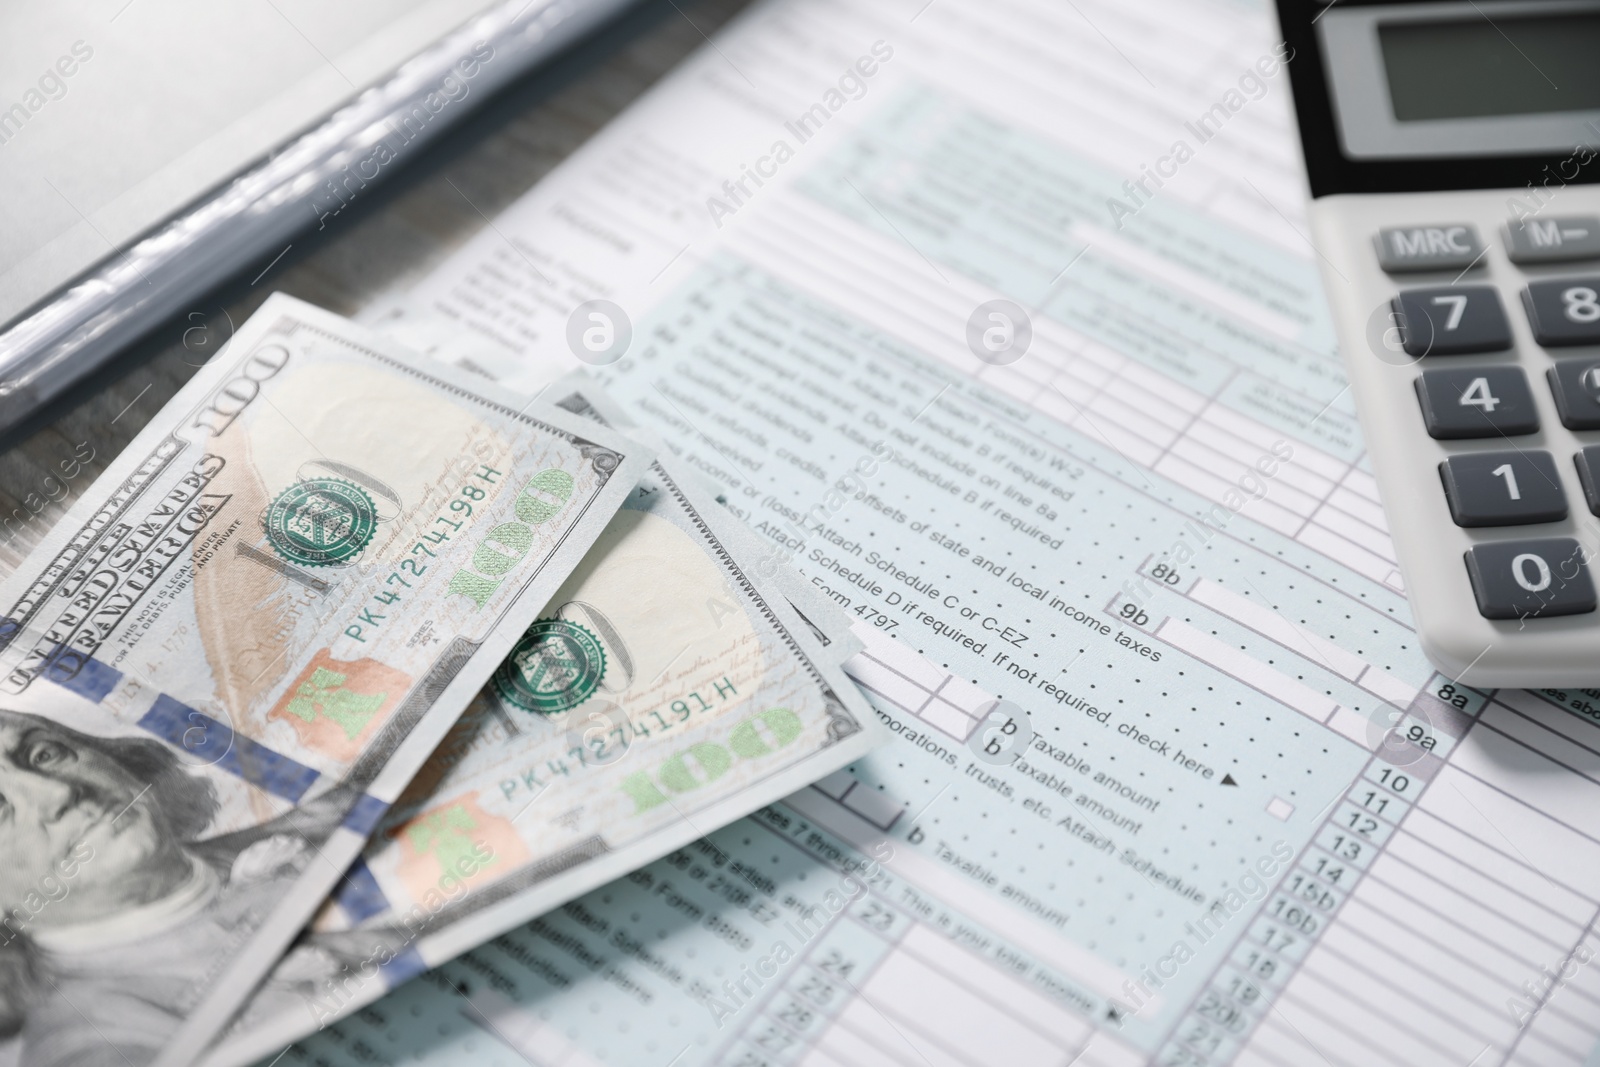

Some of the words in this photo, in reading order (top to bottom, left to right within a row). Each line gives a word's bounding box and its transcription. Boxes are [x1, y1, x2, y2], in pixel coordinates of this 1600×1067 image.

[1392, 226, 1471, 257] MRC
[1432, 295, 1467, 331] 7
[1561, 286, 1600, 322] 8
[193, 343, 290, 438] 100
[1458, 377, 1500, 412] 4
[80, 437, 181, 542] DOLLARS
[919, 442, 977, 477] include
[979, 475, 1001, 490] on
[1003, 485, 1033, 507] line
[1005, 461, 1076, 502] required
[1491, 463, 1521, 500] 1
[963, 491, 979, 504] B
[993, 506, 1065, 552] required
[57, 522, 133, 598] THE
[444, 468, 575, 614] 100
[686, 454, 741, 487] income
[742, 484, 761, 498] or
[811, 520, 863, 557] Attach
[865, 550, 940, 600] Schedule
[943, 594, 960, 610] C
[961, 605, 981, 622] or
[982, 616, 1031, 650] C-EZ
[774, 447, 827, 483] credits,
[855, 490, 908, 524] offsets
[909, 518, 930, 536] of
[929, 530, 970, 558] state
[972, 554, 1007, 577] and
[1007, 572, 1050, 602] local
[1049, 595, 1112, 636] income
[1114, 629, 1162, 664] taxes
[0, 568, 119, 695] UNITED
[107, 452, 227, 574] STATES
[48, 622, 103, 683] OF
[90, 493, 233, 641] AMERICA
[118, 623, 138, 644] THIS
[136, 598, 159, 622] NOTE
[157, 588, 169, 600] IS
[165, 564, 192, 590] LEGAL
[192, 531, 221, 564] TENDER
[1150, 562, 1181, 586] 8b
[1511, 553, 1552, 592] 0
[109, 648, 130, 668] FOR
[126, 632, 144, 650] ALL
[141, 601, 172, 631] DEBTS,
[168, 568, 199, 600] PUBLIC
[196, 550, 215, 570] AND
[211, 519, 243, 552] PRIVATE
[406, 619, 434, 648] SERIES
[1119, 602, 1150, 627] 9b
[754, 519, 806, 554] Attach
[808, 547, 885, 597] Schedule
[886, 591, 902, 607] D
[902, 601, 920, 614] if
[917, 609, 987, 659] required.
[990, 652, 1008, 666] If
[1006, 661, 1038, 684] not
[1036, 679, 1112, 728] required,
[1118, 722, 1170, 757] check
[1173, 750, 1215, 781] here
[1437, 684, 1469, 710] 8a
[1000, 717, 1018, 736] b
[1406, 725, 1438, 752] 9a
[613, 706, 804, 815] 100
[984, 737, 1002, 756] b
[964, 762, 1015, 802] trusts,
[1028, 731, 1091, 776] Taxable
[1094, 770, 1160, 814] amount
[1378, 768, 1410, 793] 10
[1009, 752, 1073, 796] Taxable
[1076, 793, 1143, 836] amount
[1363, 792, 1390, 814] 11
[907, 825, 925, 845] b
[1348, 813, 1379, 838] 12
[1332, 836, 1362, 860] 13
[1316, 858, 1345, 884] 14
[1262, 926, 1296, 953] 17
